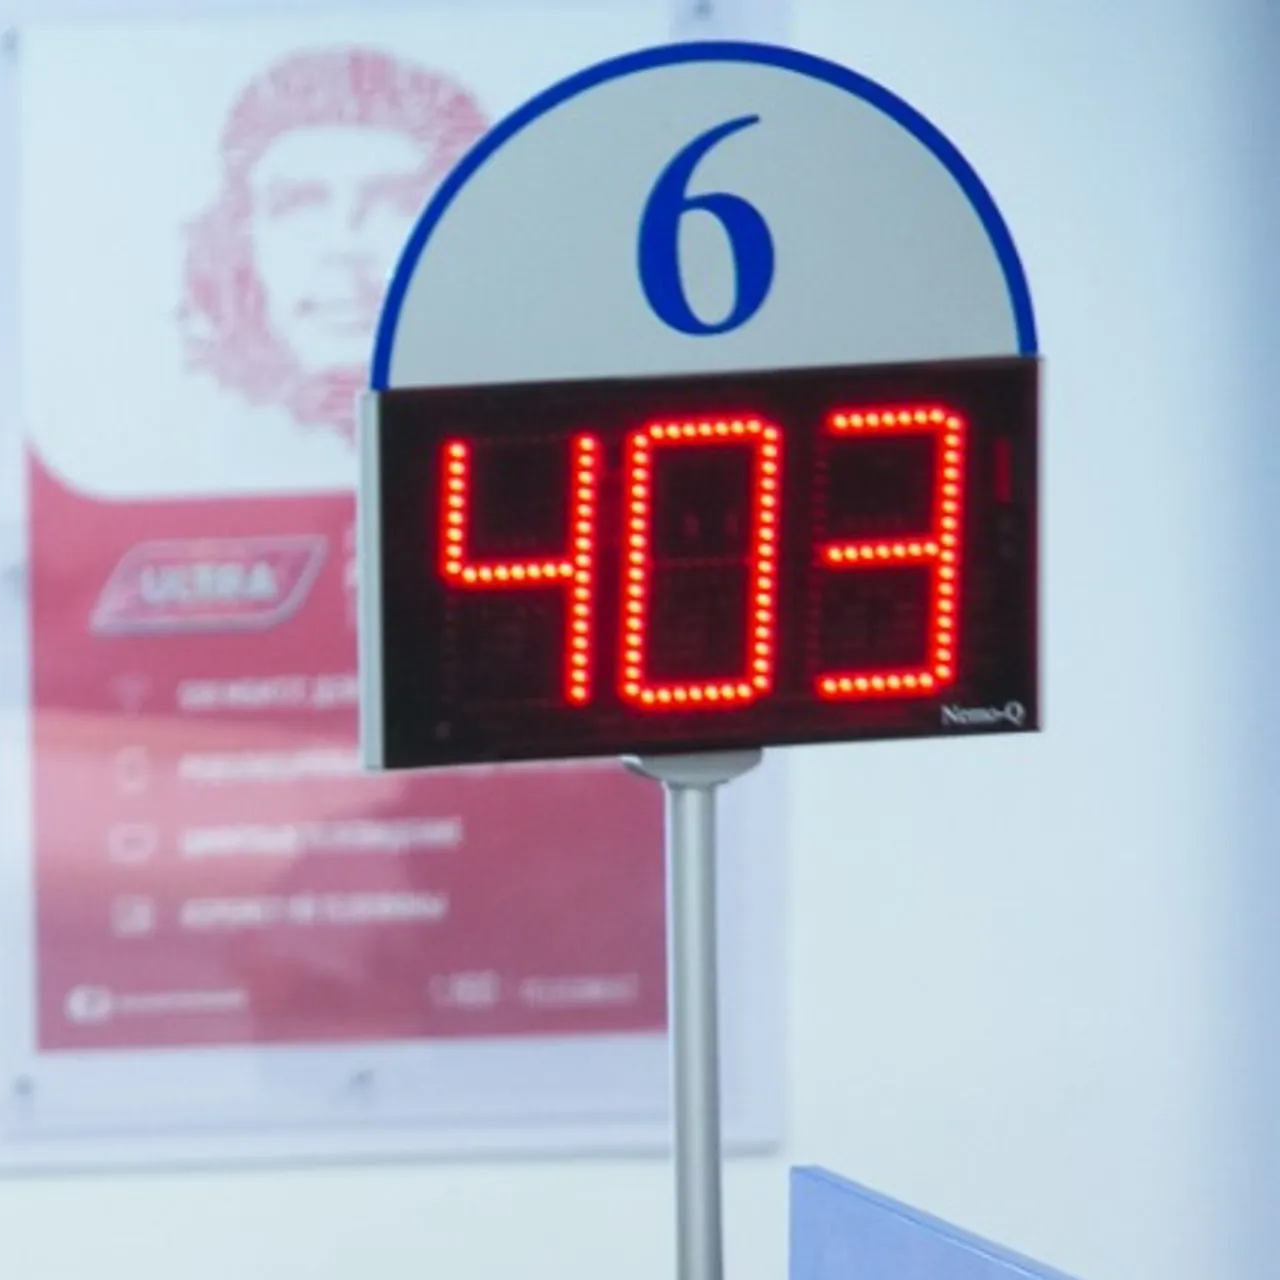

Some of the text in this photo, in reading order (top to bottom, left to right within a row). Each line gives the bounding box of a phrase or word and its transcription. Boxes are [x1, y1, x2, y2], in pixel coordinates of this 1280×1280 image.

[639, 113, 776, 337] 6
[442, 408, 964, 706] 403
[941, 699, 1026, 728] Nemo-Q
